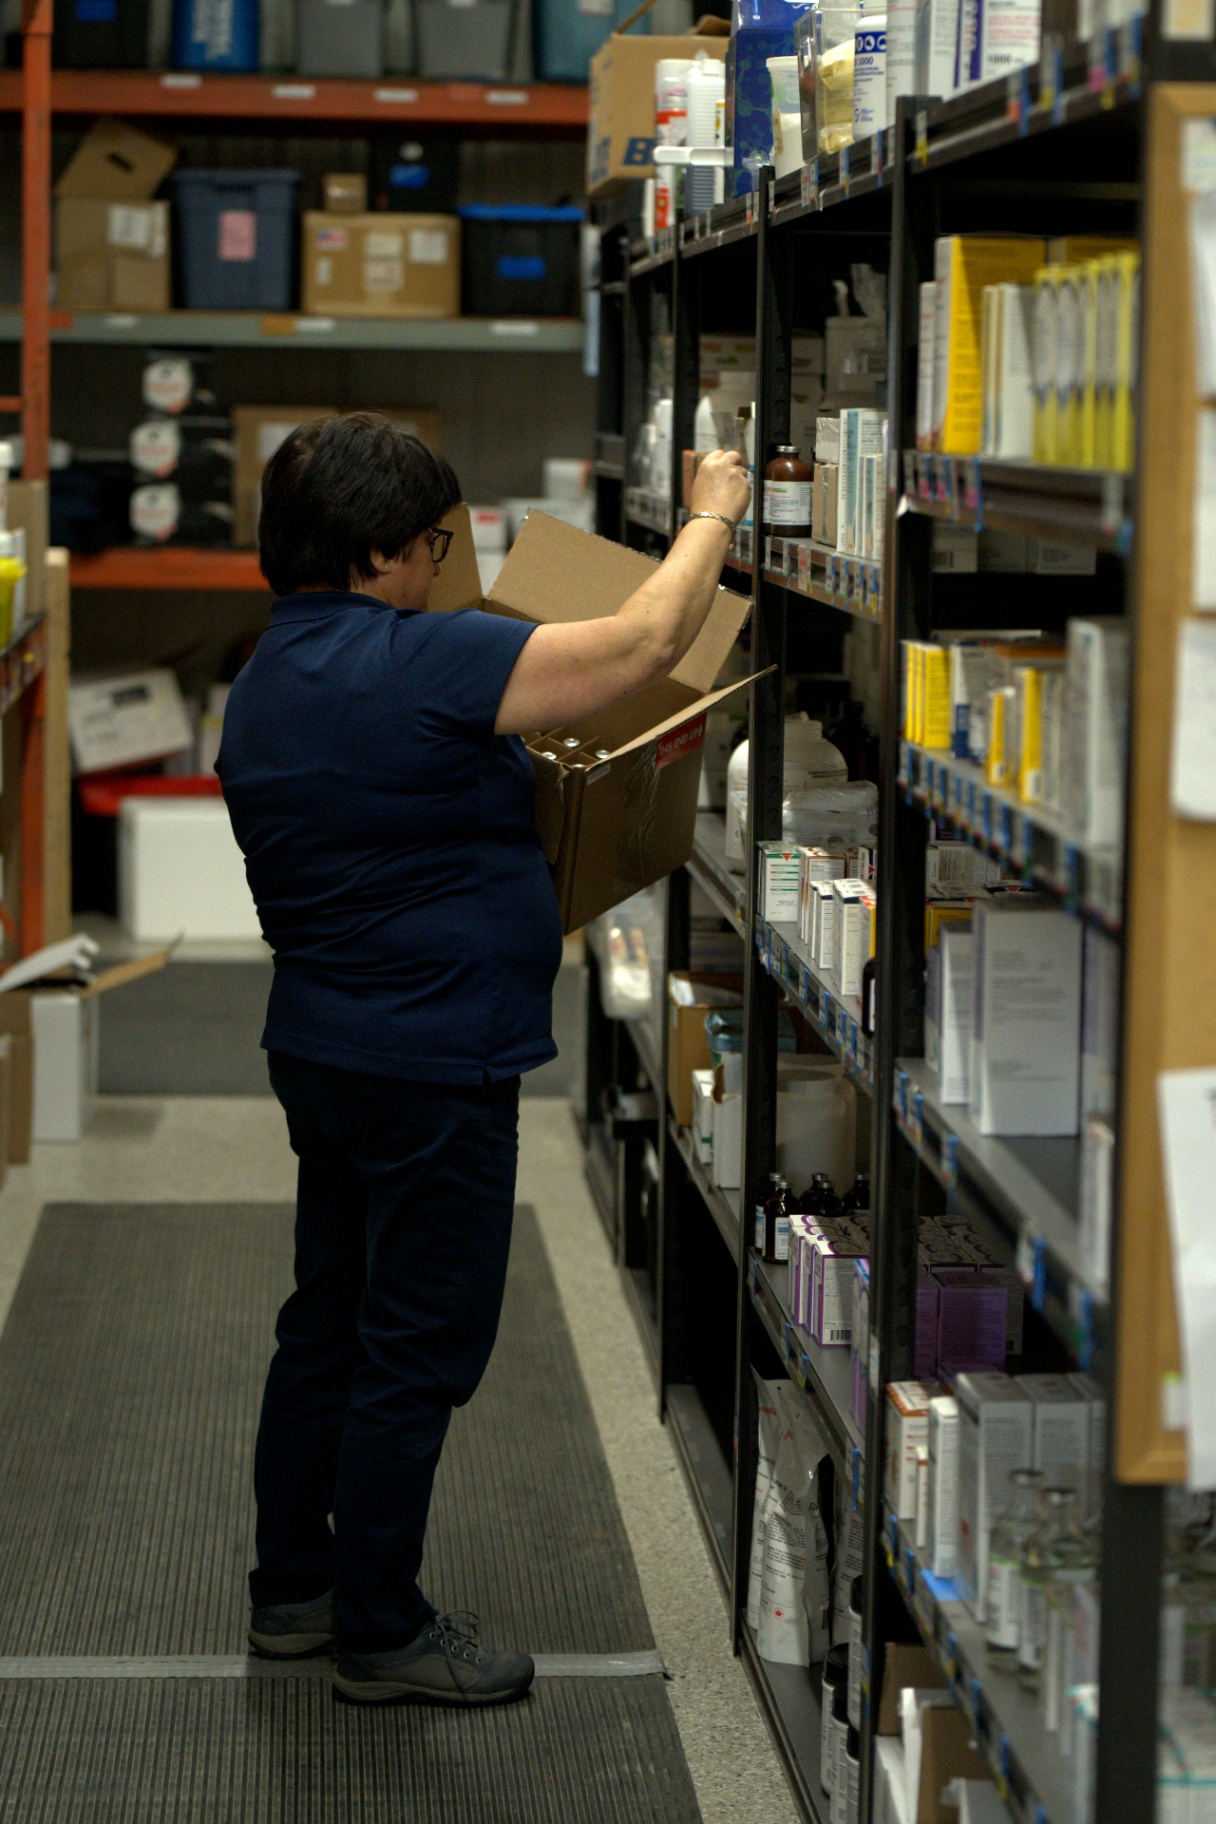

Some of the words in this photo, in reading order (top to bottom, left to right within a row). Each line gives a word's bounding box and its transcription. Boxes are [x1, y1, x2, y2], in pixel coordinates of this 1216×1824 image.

[658, 742, 673, 755] THIS
[674, 733, 688, 747] END
[689, 728, 700, 741] UP
